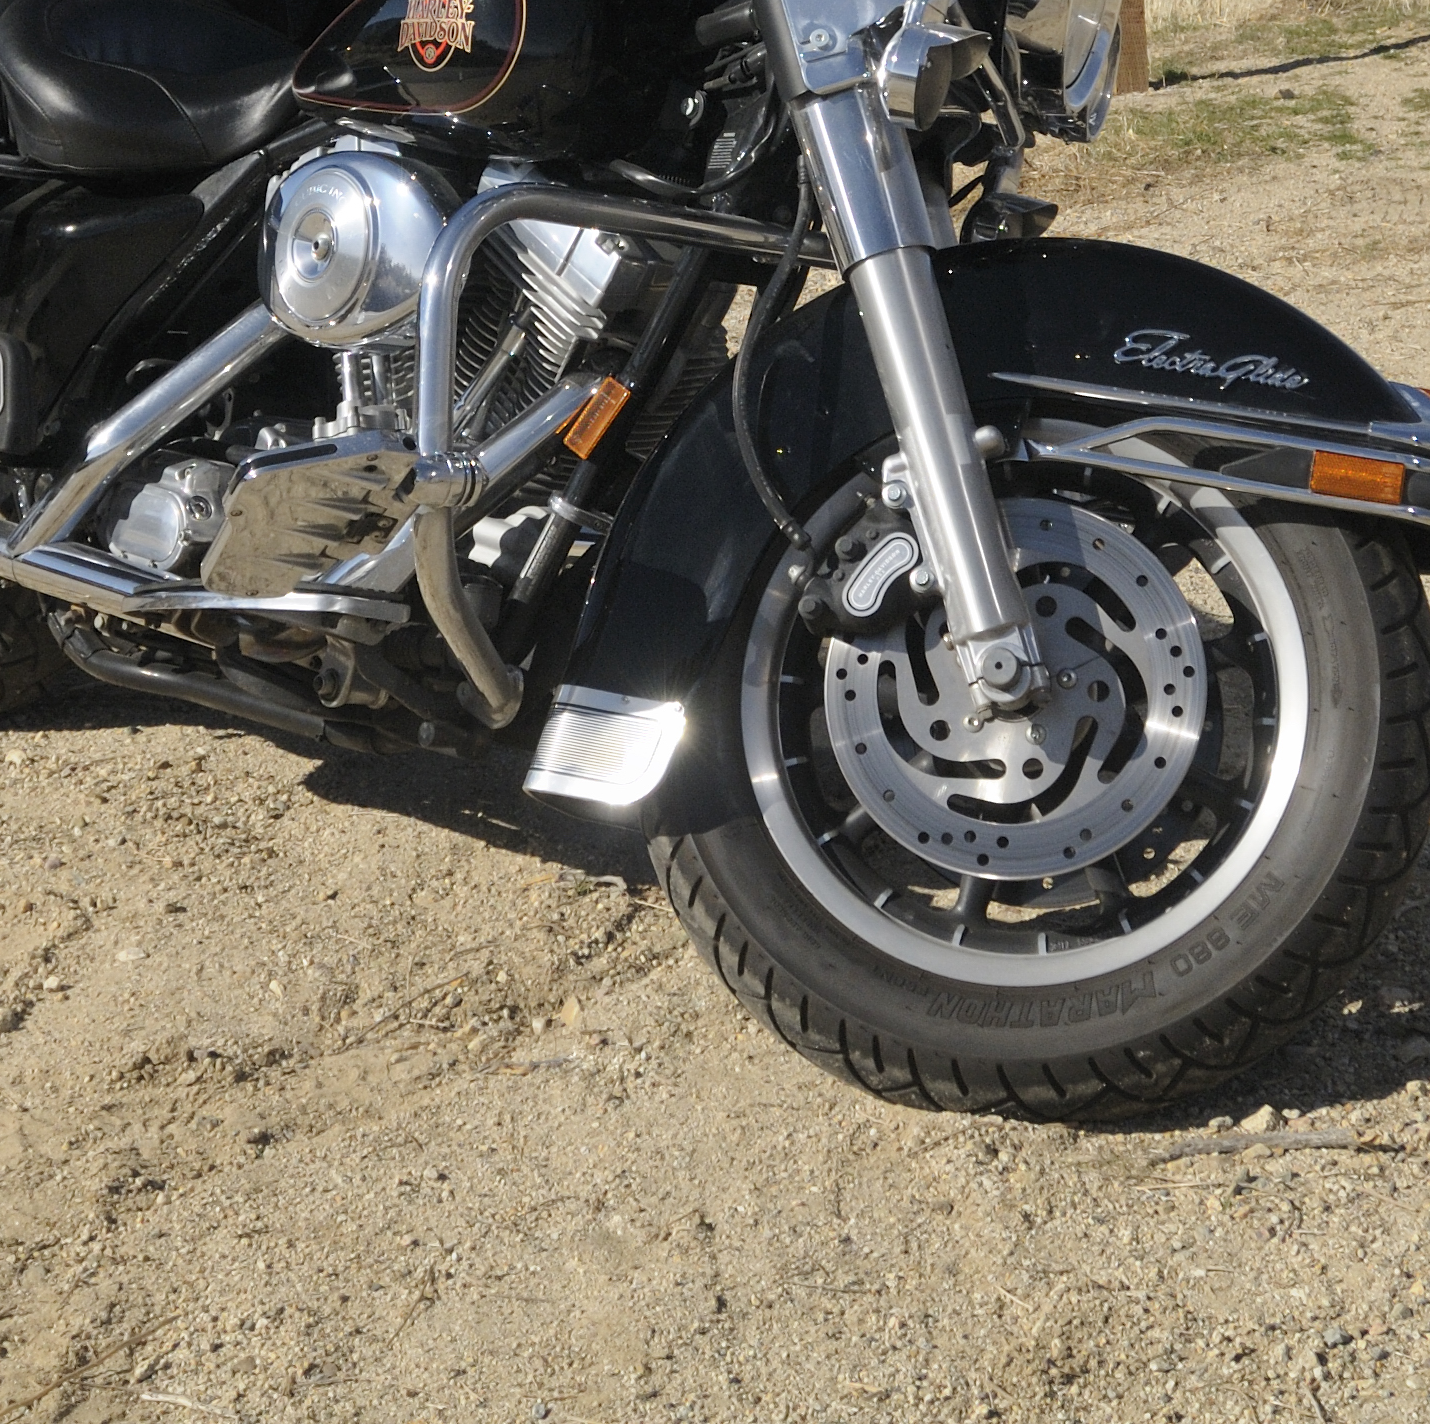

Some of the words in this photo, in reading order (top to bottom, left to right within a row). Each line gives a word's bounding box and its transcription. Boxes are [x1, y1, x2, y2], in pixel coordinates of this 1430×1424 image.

[397, 18, 475, 54] DAVIDSON
[1231, 872, 1285, 931] ME
[1170, 927, 1231, 977] 880
[926, 970, 1157, 1029] MARATHON
